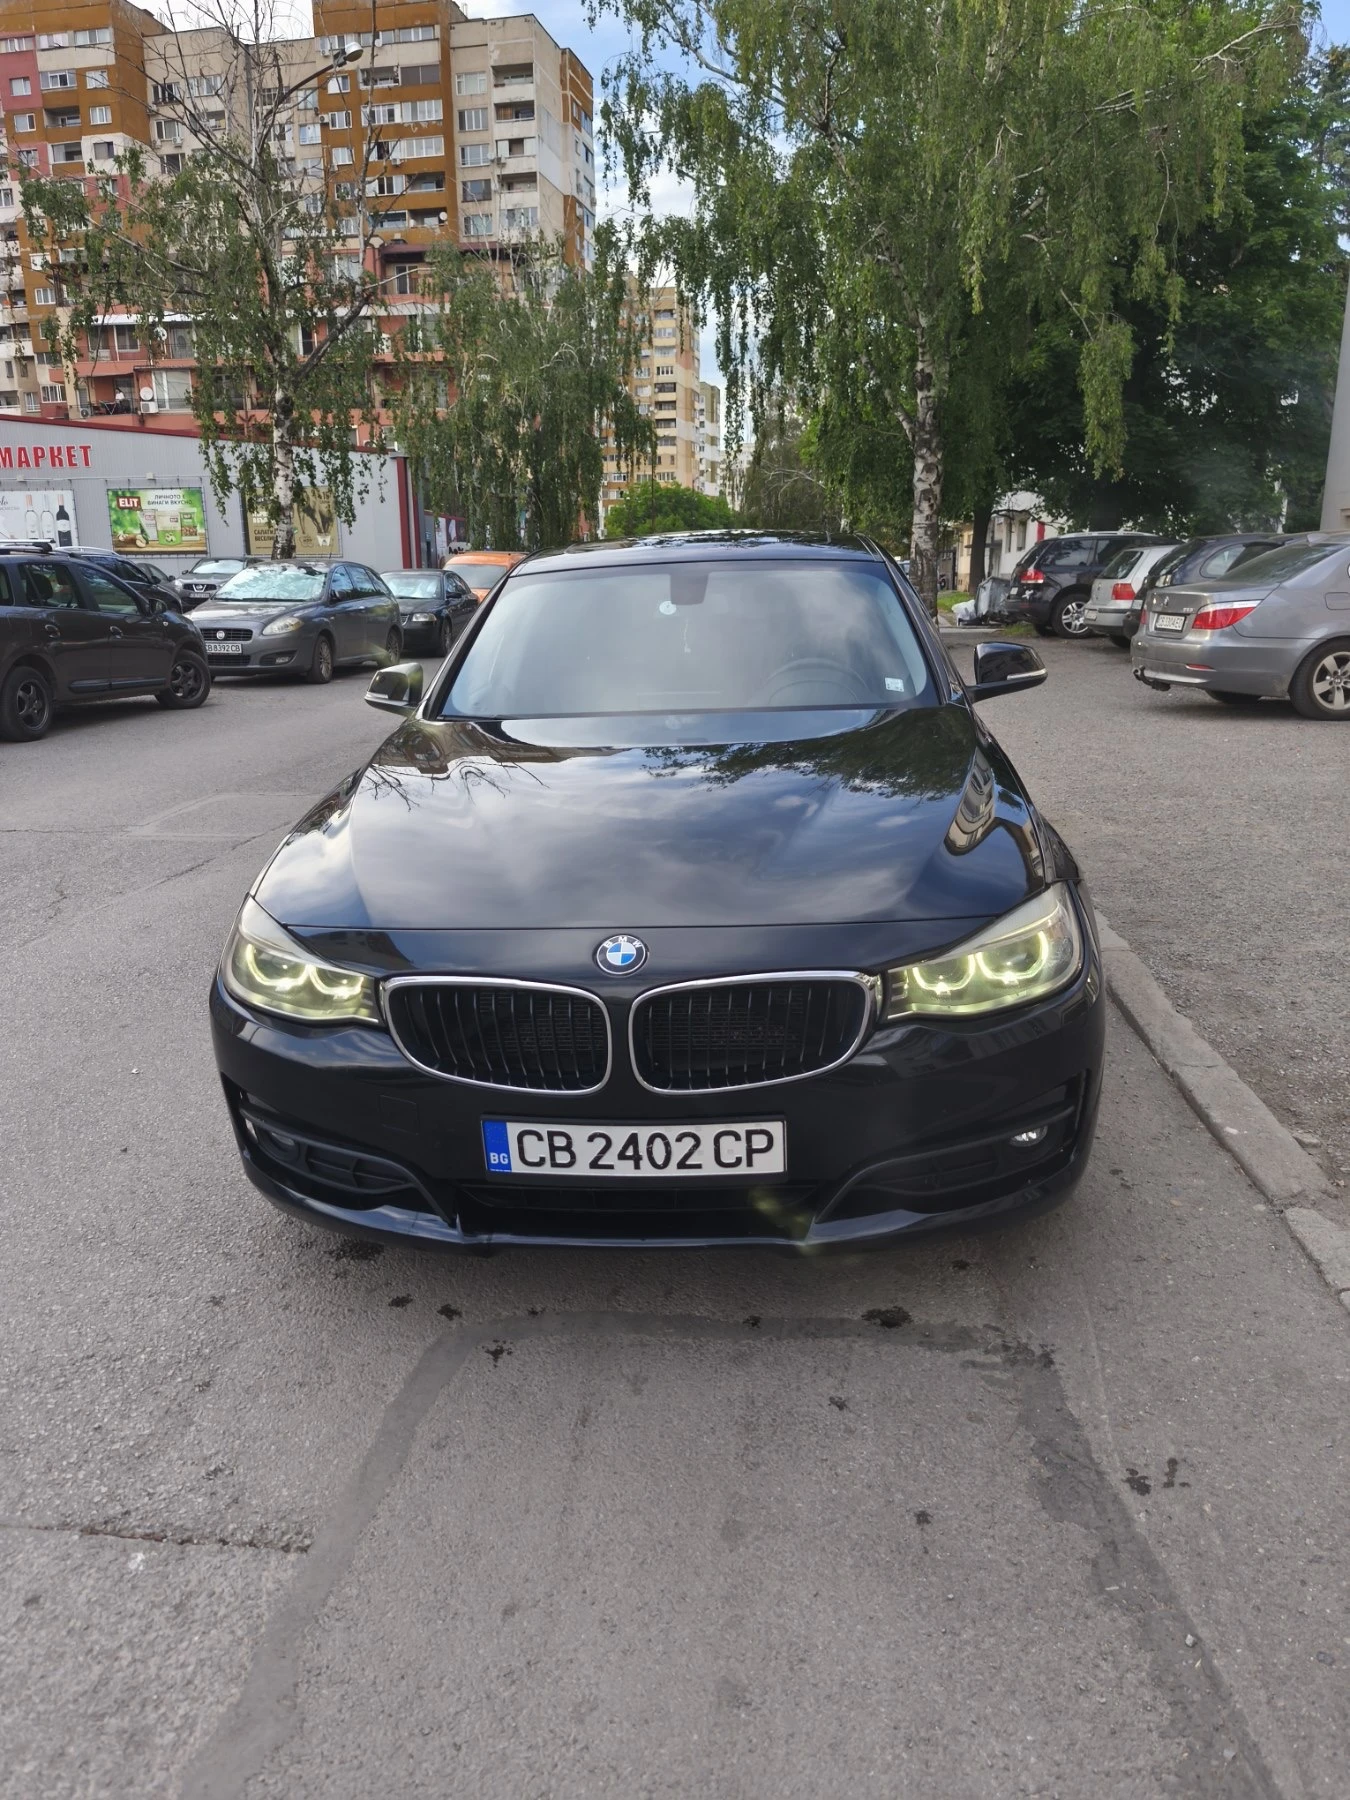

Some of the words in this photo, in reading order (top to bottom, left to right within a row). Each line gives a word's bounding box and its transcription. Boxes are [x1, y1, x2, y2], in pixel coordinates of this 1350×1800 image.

[0, 445, 92, 468] МАРКЕТ
[119, 498, 138, 507] ELIT
[603, 936, 643, 949] BMW
[489, 1152, 509, 1165] BG
[516, 1129, 577, 1168] CB
[586, 1131, 703, 1170] 2402
[713, 1128, 774, 1168] CP
